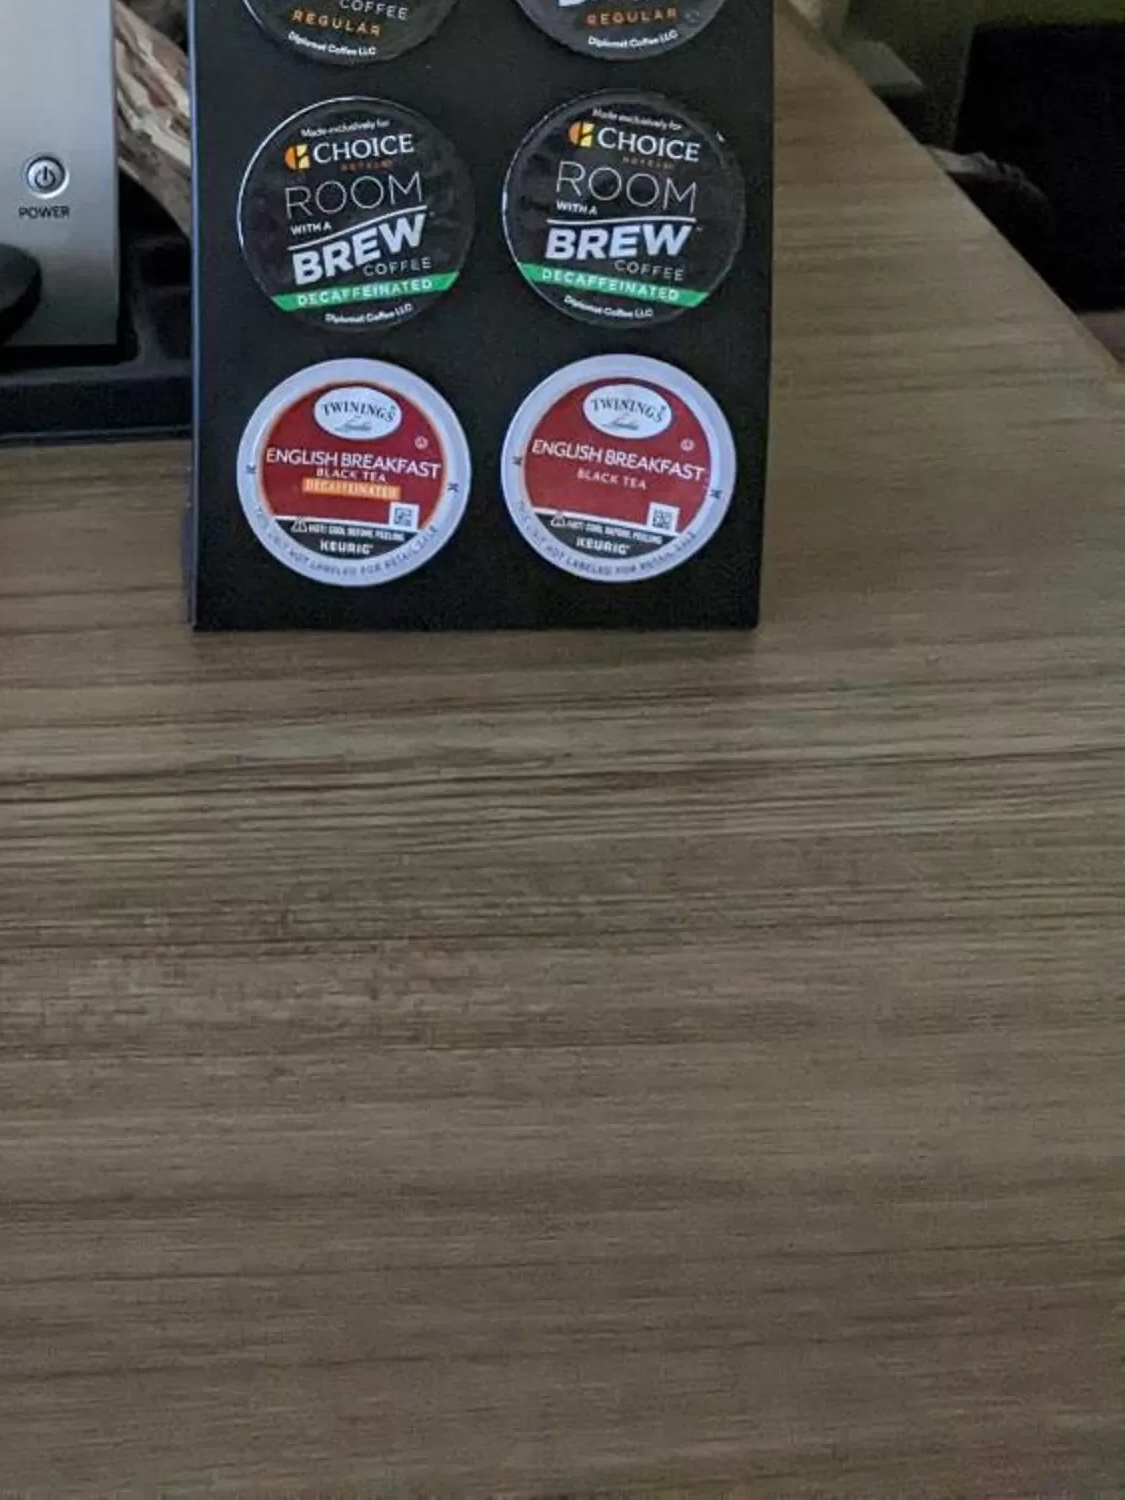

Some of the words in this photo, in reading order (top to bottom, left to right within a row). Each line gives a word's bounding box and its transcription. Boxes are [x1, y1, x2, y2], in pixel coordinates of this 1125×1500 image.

[292, 9, 380, 36] REGULAR
[586, 7, 677, 26] REGULAR
[313, 133, 415, 164] CHOICE
[597, 127, 701, 162] CHOICE
[284, 171, 423, 220] ROOM
[556, 160, 698, 214] ROOM
[18, 205, 70, 219] POWER
[555, 200, 587, 214] WITH
[587, 205, 598, 216] A
[290, 223, 323, 236] WITH
[322, 221, 332, 231] A
[544, 224, 692, 260] BREW
[292, 213, 425, 285] BREW
[362, 256, 433, 277] COFFEE
[614, 260, 684, 281] COFFEE
[297, 279, 433, 308] DECAFFEINATED
[542, 269, 680, 301] DECAFFEINATED
[322, 400, 395, 422] TWININGS
[591, 396, 665, 423] TWININGS
[266, 447, 339, 467] ENGLISH
[341, 452, 442, 479] BREAKFAST
[531, 439, 602, 464] ENGLISH
[604, 449, 706, 482] BREAKFAST
[316, 467, 358, 479] BLACK
[363, 470, 386, 482] TEA
[577, 468, 619, 485] BLACK
[623, 475, 647, 490] TEA
[319, 539, 371, 555] KEURIG
[576, 537, 628, 555] KEURIG
